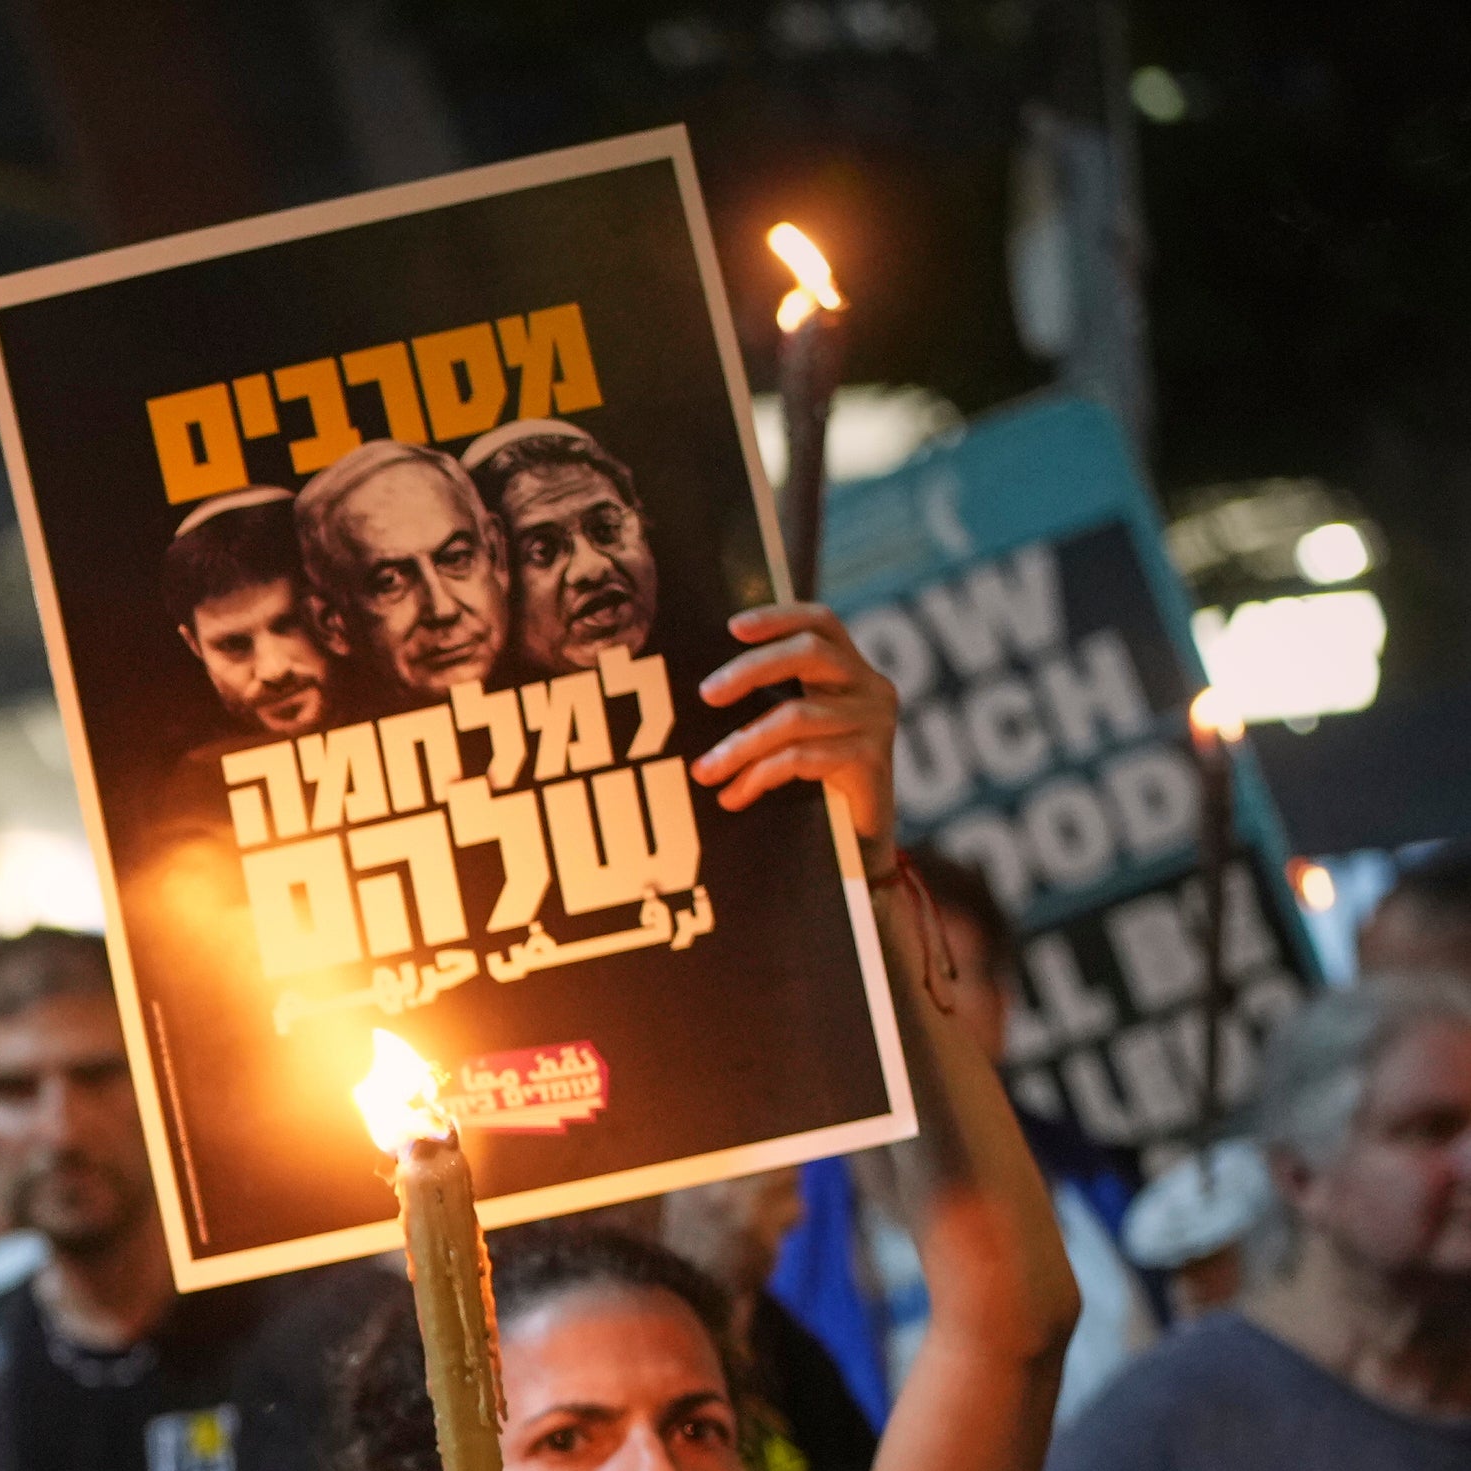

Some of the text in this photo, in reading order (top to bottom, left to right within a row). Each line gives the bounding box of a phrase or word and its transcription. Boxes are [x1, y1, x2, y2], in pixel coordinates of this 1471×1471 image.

[145, 301, 604, 506] מסרבים
[220, 643, 675, 848] למלחמה
[240, 756, 703, 980] שלהם
